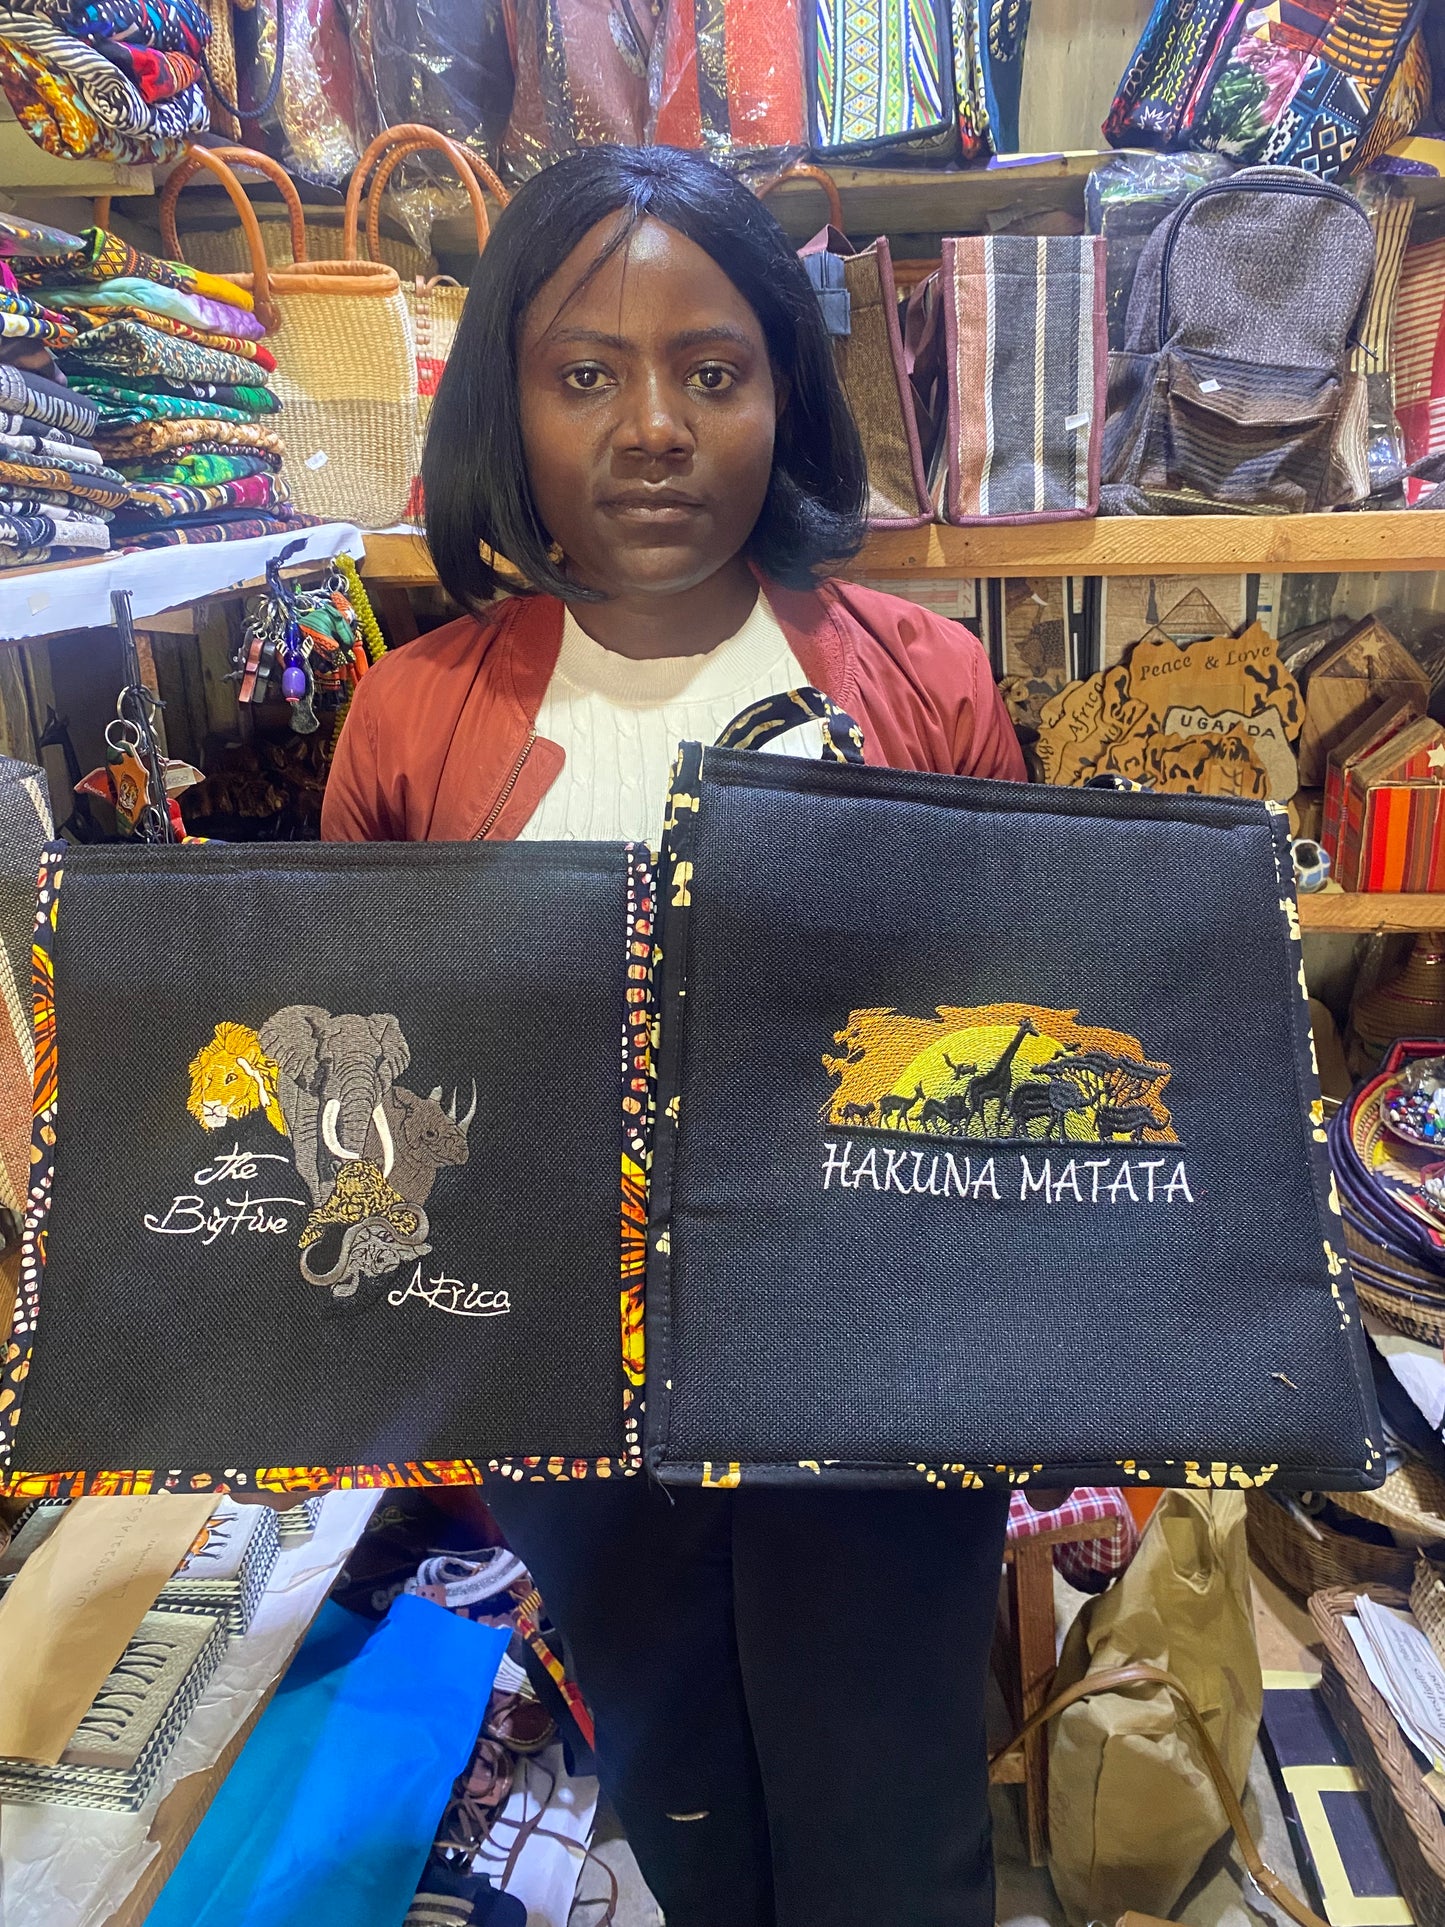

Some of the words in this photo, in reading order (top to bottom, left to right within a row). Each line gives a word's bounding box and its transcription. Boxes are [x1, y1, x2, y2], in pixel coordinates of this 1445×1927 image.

[1139, 655, 1193, 682] Peace
[1204, 655, 1221, 671] &
[1225, 645, 1272, 667] Love
[1068, 681, 1104, 742] Africa
[821, 1140, 1002, 1200] HAKUNA
[1019, 1154, 1194, 1204] MATATA
[387, 1261, 512, 1317] Africa
